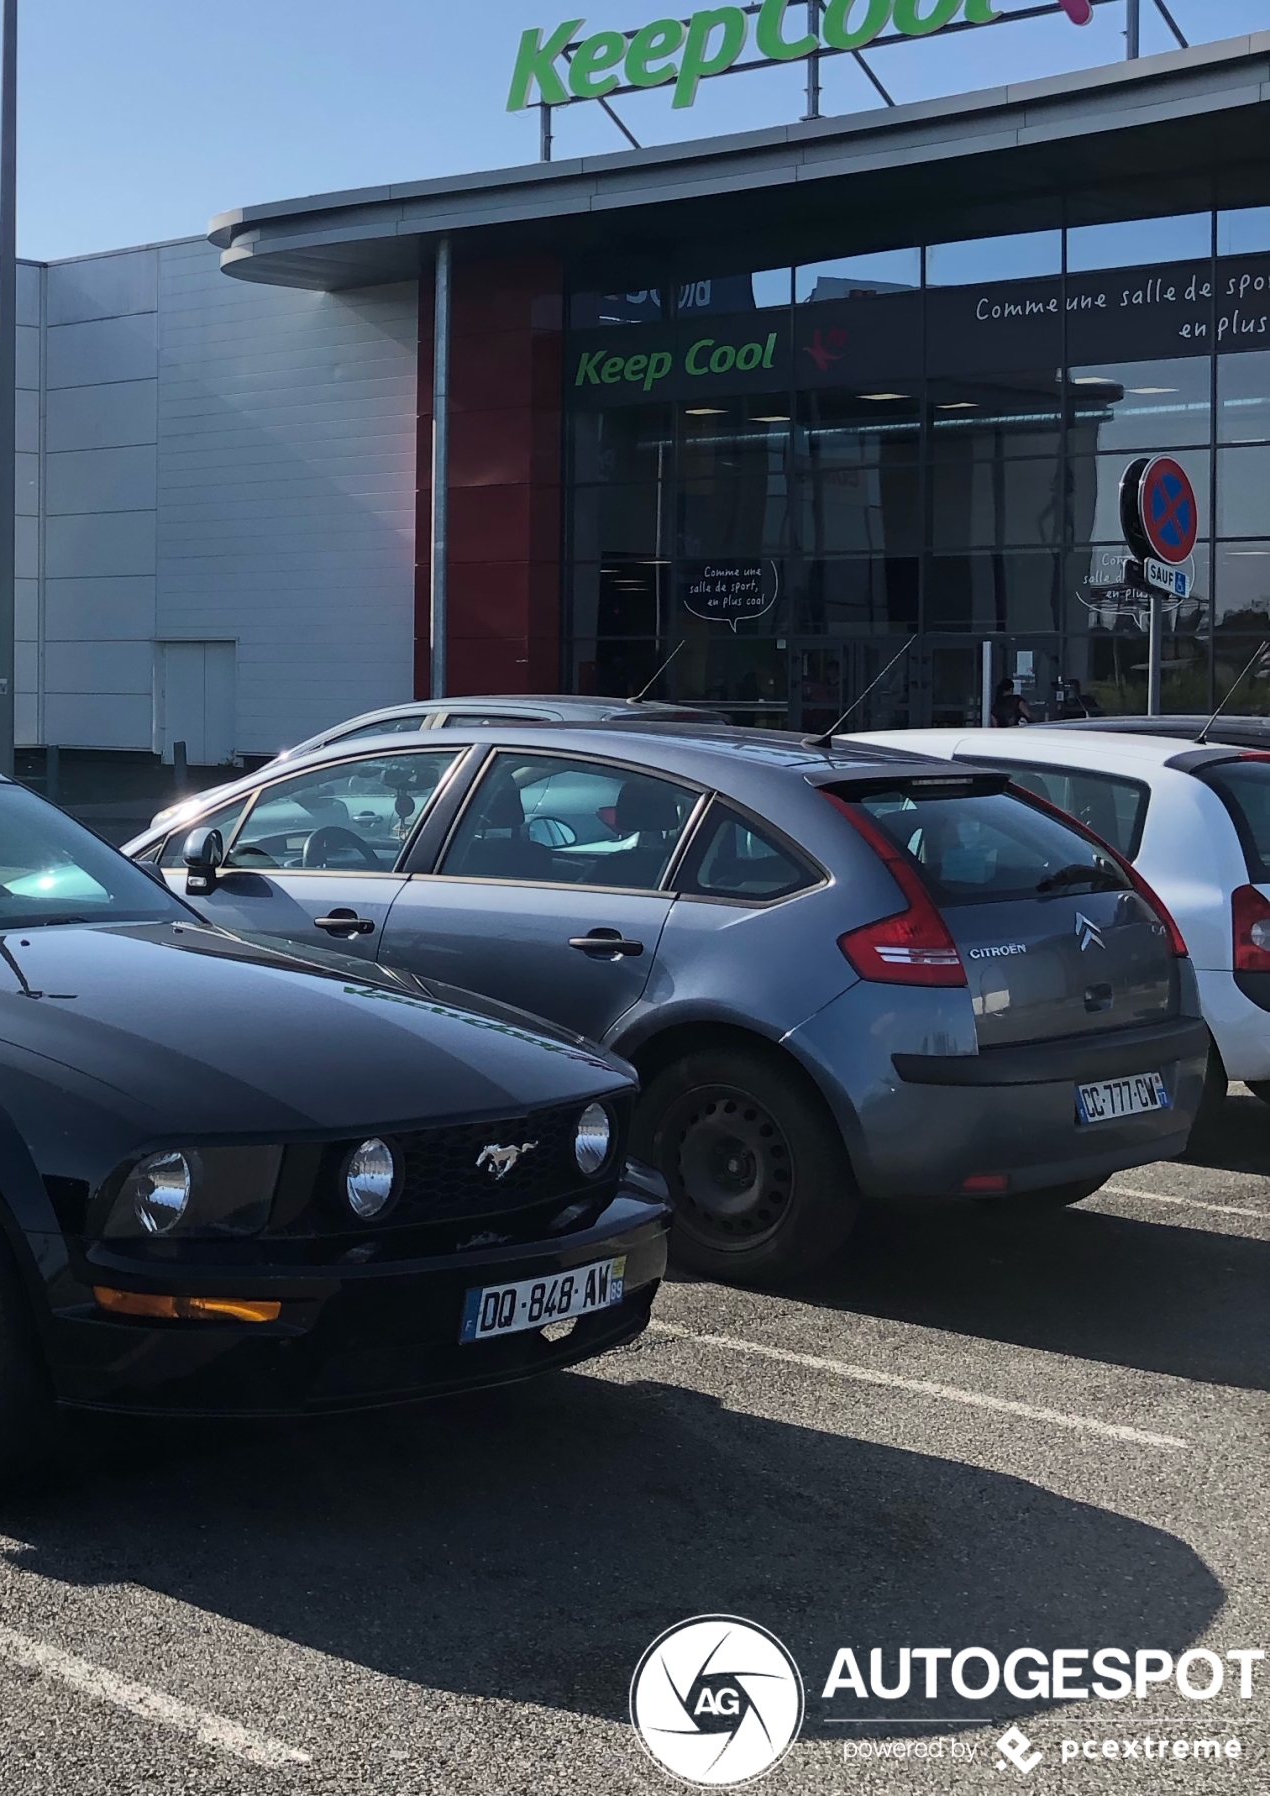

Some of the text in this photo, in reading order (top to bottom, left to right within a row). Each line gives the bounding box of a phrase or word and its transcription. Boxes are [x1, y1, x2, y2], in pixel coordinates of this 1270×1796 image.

[505, 0, 1004, 112] Keep Coo
[976, 274, 1270, 320] Comme une salle de spo
[1179, 309, 1268, 341] en plus
[575, 332, 778, 391] Keep Cool
[704, 565, 762, 578] Comme une
[1083, 570, 1110, 585] salle
[1150, 564, 1174, 587] SAUF
[689, 580, 712, 594] salle
[715, 580, 727, 592] de
[1106, 589, 1119, 599] en
[707, 598, 719, 607] en
[722, 594, 742, 608] plus
[969, 942, 1027, 960] CITROËN
[464, 1320, 472, 1331] F
[611, 1280, 623, 1300] 89
